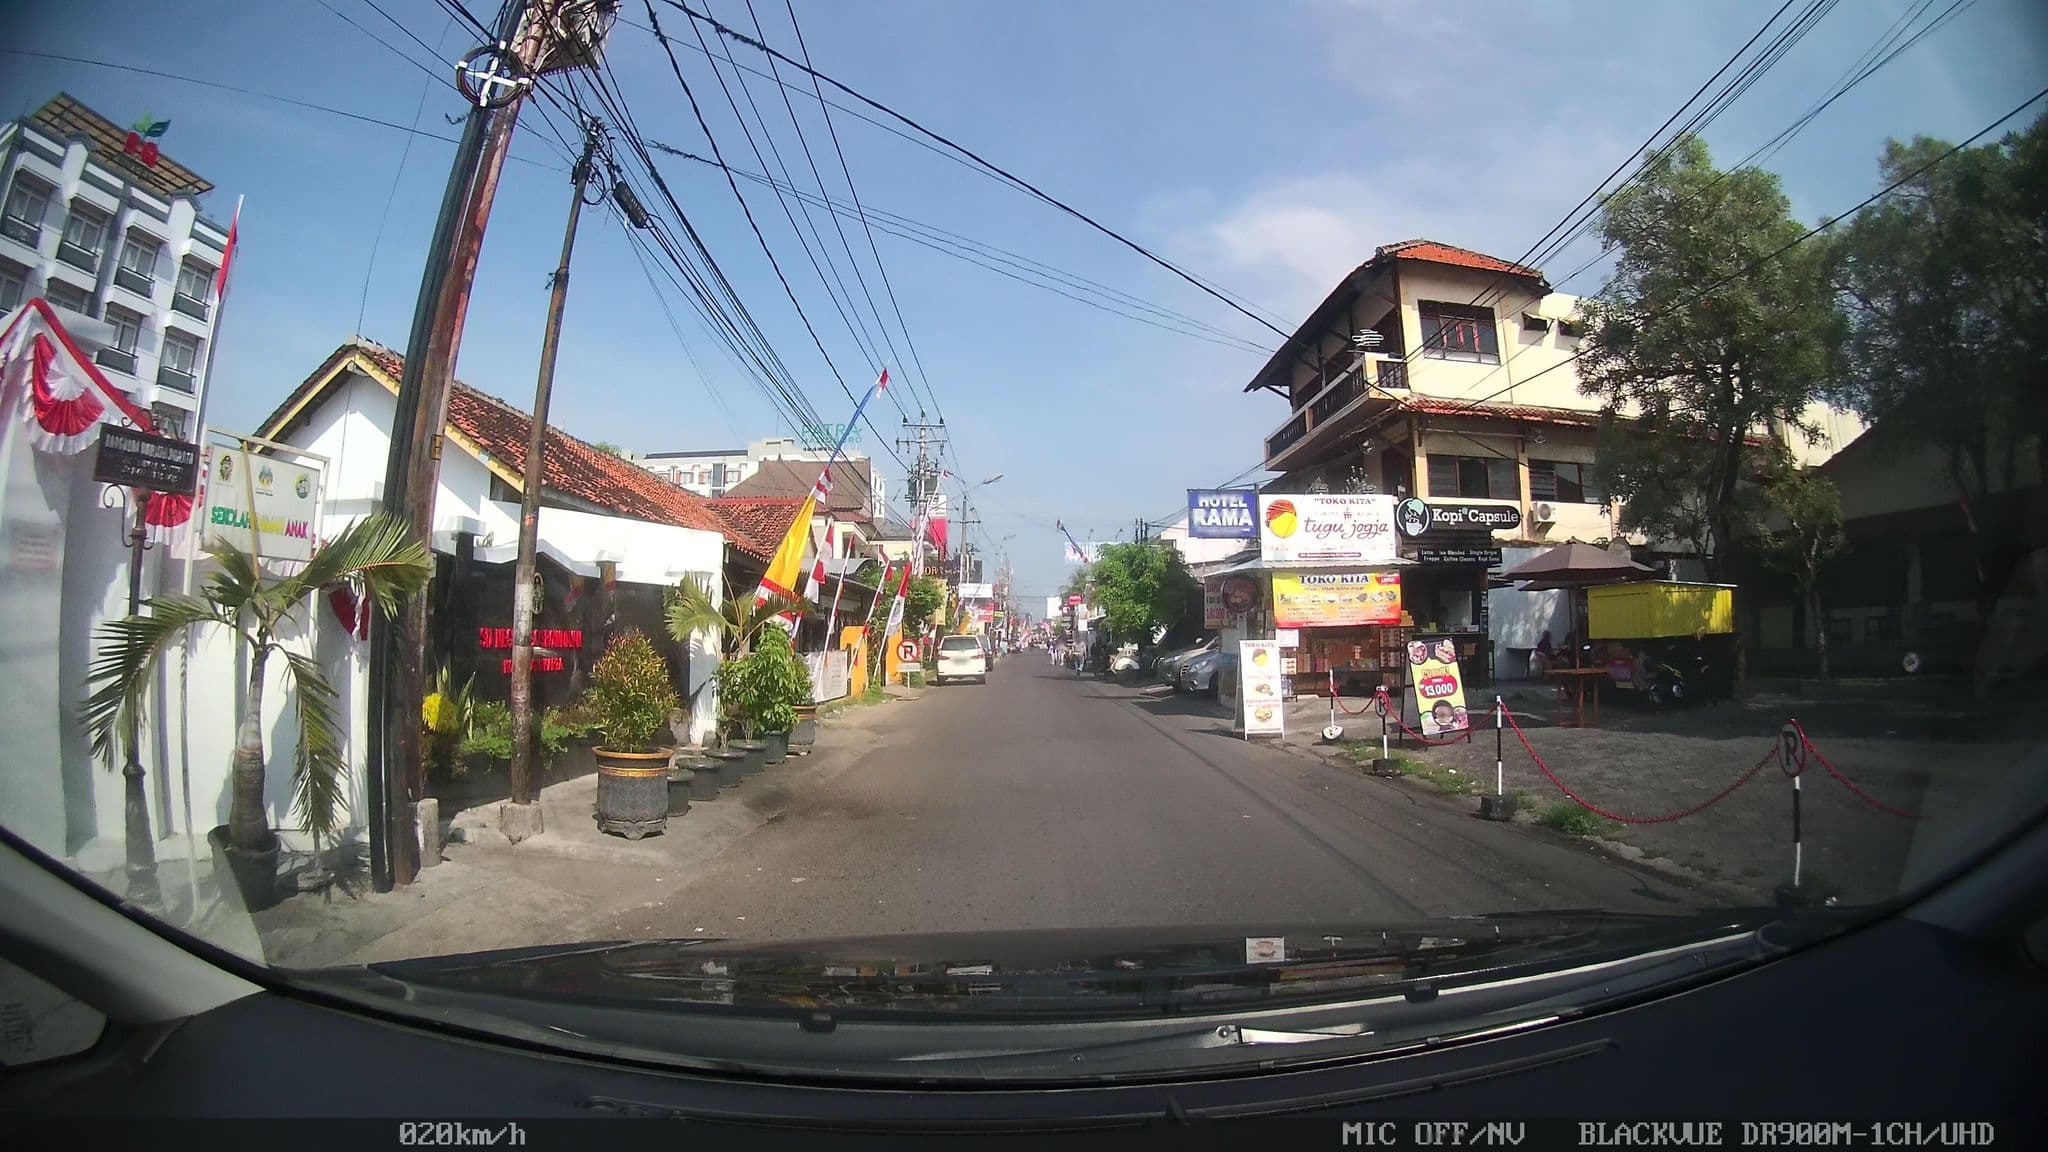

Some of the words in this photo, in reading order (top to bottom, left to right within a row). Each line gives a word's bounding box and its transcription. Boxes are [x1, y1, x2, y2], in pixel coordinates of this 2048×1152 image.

[1198, 494, 1248, 508] HOTEL
[1431, 508, 1463, 525] Kopi
[1468, 509, 1519, 526] Capsule
[284, 519, 309, 539] ANAK
[1304, 517, 1345, 540] tugu
[1341, 519, 1389, 540] jogja
[1298, 575, 1336, 584] TOKO
[1340, 574, 1369, 583] KITA
